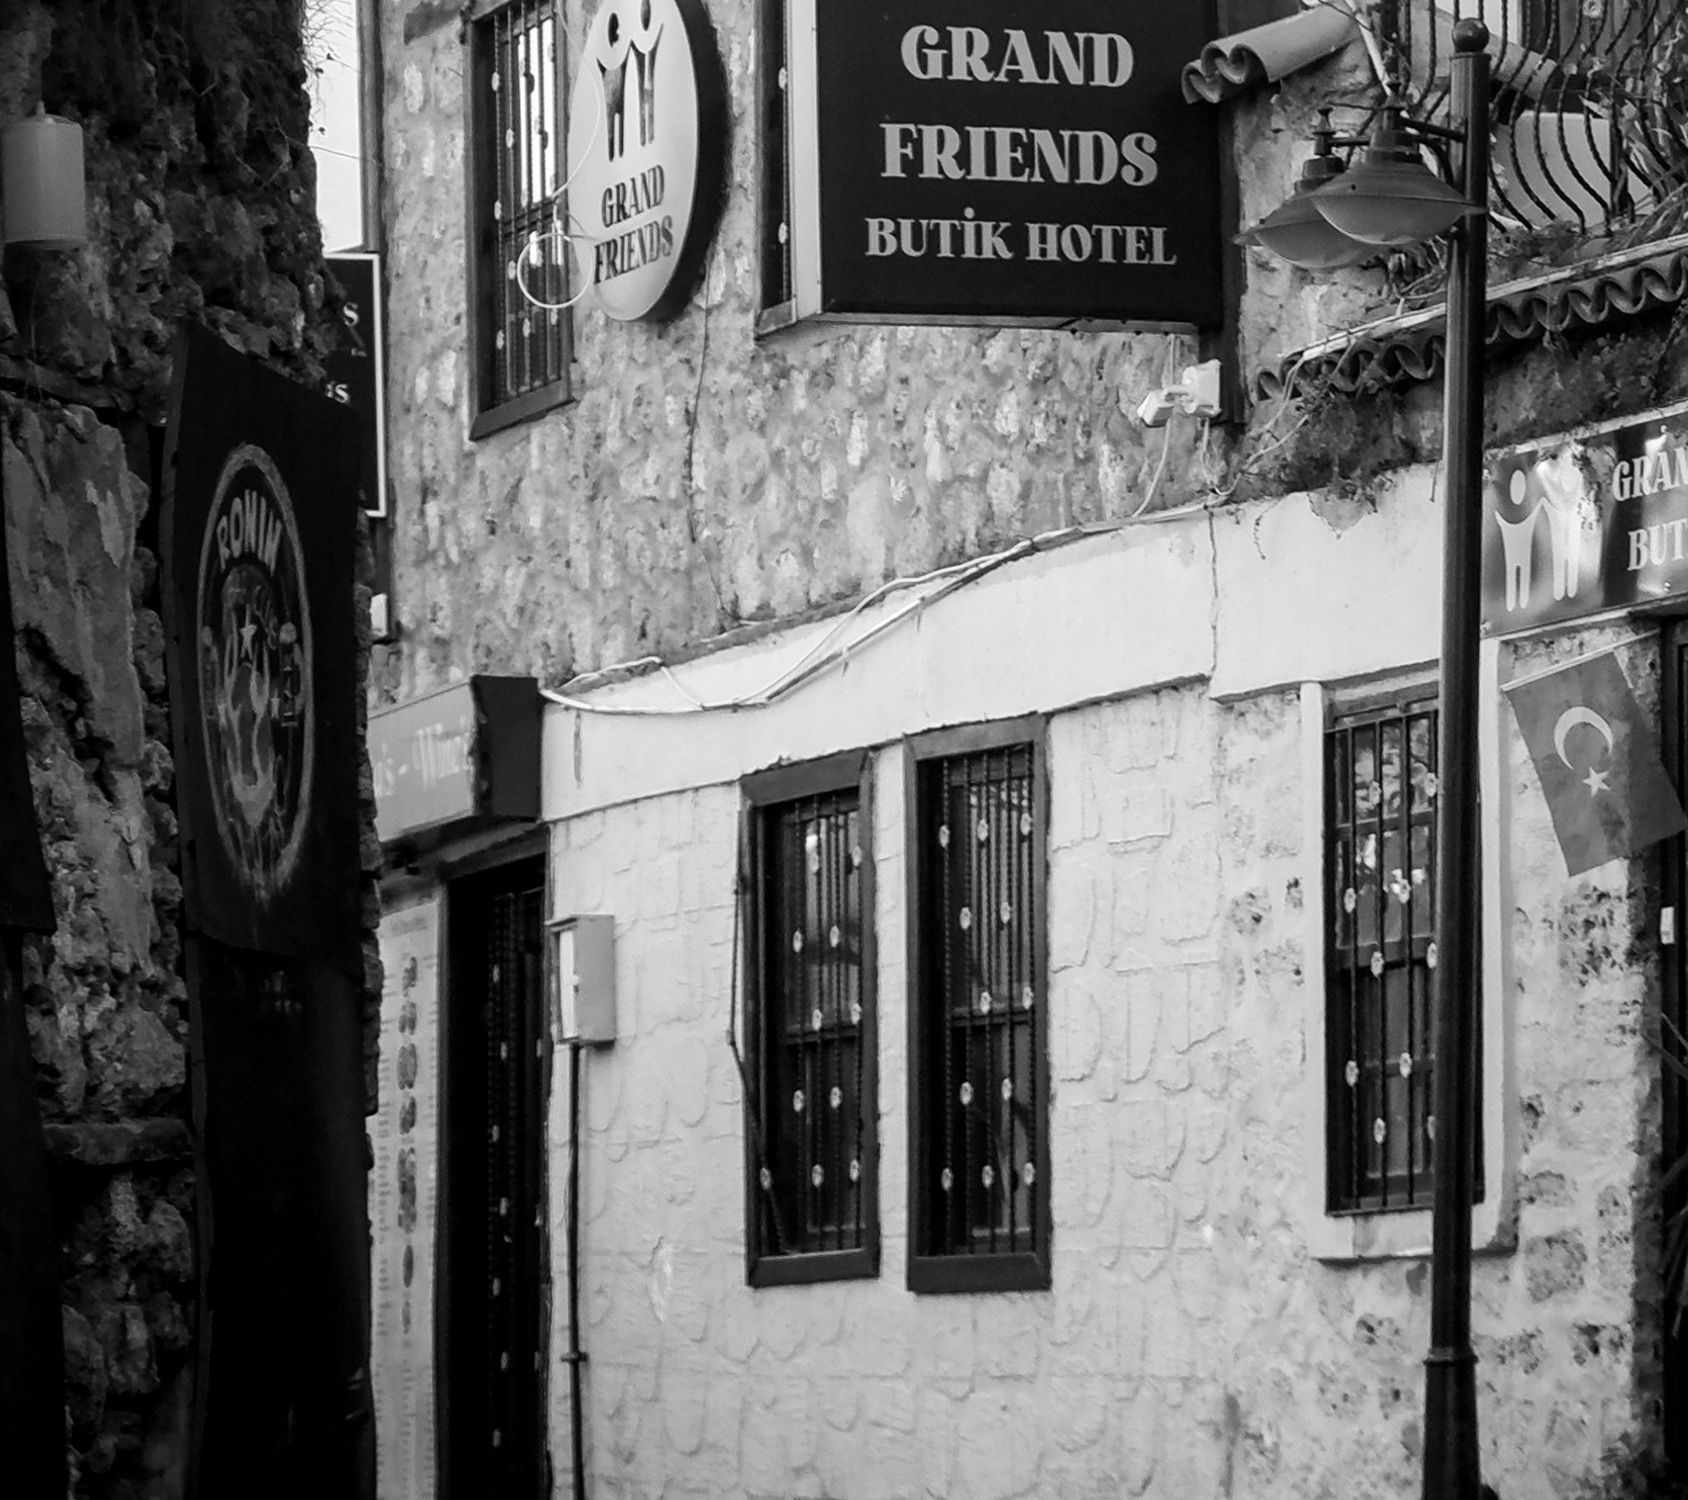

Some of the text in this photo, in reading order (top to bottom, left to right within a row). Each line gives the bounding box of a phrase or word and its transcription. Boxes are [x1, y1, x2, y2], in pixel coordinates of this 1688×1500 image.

[900, 24, 1133, 87] GRAND
[879, 122, 1158, 187] FRIENDS
[601, 163, 665, 228] GRAND
[593, 214, 674, 286] FRIENDS
[865, 207, 1176, 265] BUTİK HOTEL
[215, 488, 283, 578] RONIN
